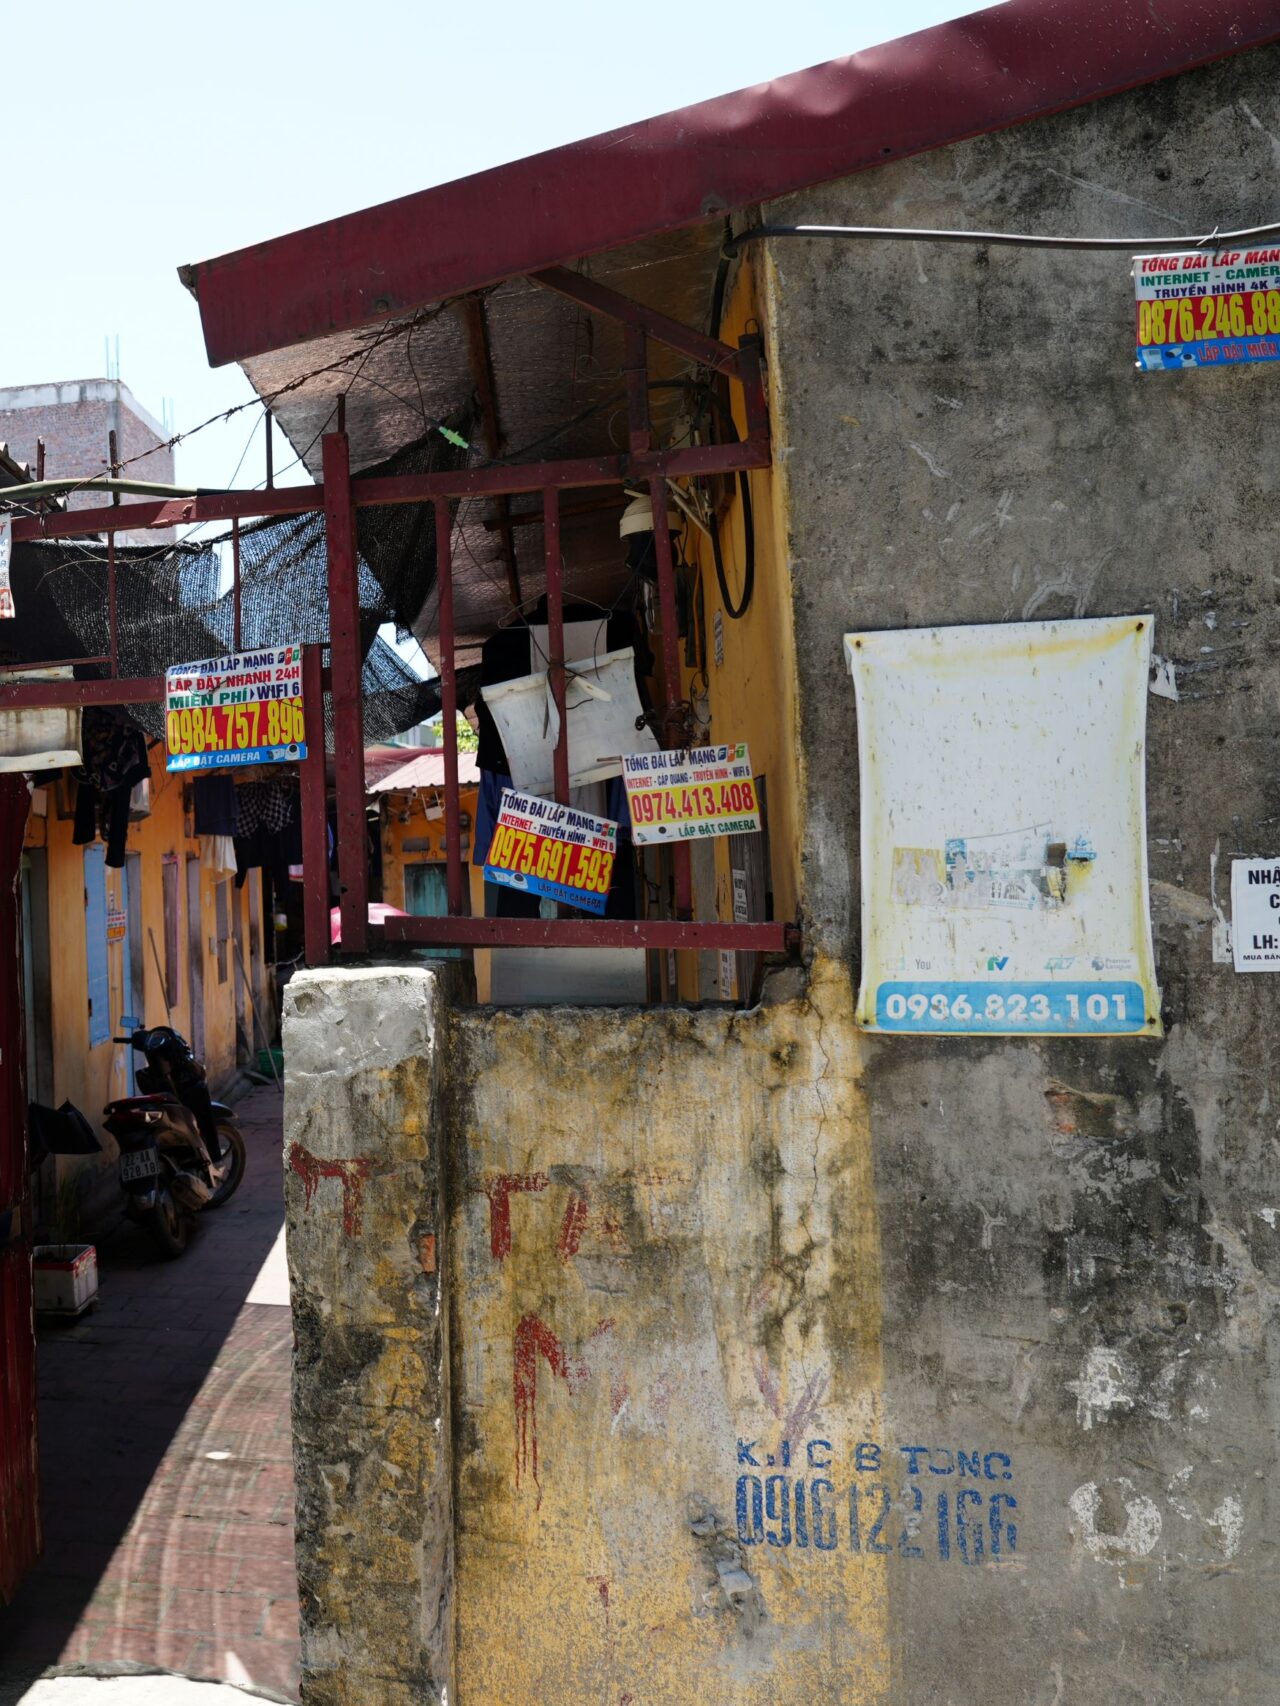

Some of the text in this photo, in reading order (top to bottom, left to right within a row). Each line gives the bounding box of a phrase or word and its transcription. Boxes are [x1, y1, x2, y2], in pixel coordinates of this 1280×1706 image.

[1142, 256, 1179, 272] TỔNG
[1212, 249, 1240, 267] LẮP
[1244, 249, 1280, 266] MẠN
[1141, 265, 1280, 286] INTERNET CAMER
[1155, 280, 1268, 298] TRUYỀN HÌNH 4K
[1139, 290, 1280, 345] 0876.246.88
[201, 660, 217, 675] ĐÀI
[221, 655, 240, 672] LẮP
[243, 653, 273, 670] MẠNG
[168, 666, 299, 693] LẮP ĐẶT NHANH 24H
[220, 688, 247, 703] PHÍ
[257, 683, 288, 699] WIFI
[292, 682, 299, 696] 6
[168, 698, 304, 755] 0984.757.896
[216, 751, 260, 764] CAMERA
[625, 755, 649, 772] TỔNG
[652, 754, 666, 769] ĐÀI
[689, 749, 716, 767] MẠNG
[718, 744, 745, 762] FPT
[733, 766, 746, 778] WIFI
[746, 766, 750, 776] 6
[503, 791, 529, 814] TỔNG
[529, 802, 547, 818] ĐÀI
[547, 805, 565, 823] LẮP
[567, 812, 595, 831] MẠNG
[631, 783, 754, 822] 0974.413.408
[501, 813, 533, 831] INTERNET
[540, 824, 566, 839] TRUYỀN
[567, 829, 586, 844] HÌNH
[593, 837, 608, 849] WIFI
[679, 820, 756, 837] LẮP ĐẶT CAMERA
[489, 825, 613, 894] 0975.691.593
[1248, 866, 1280, 887] NHẬ
[1253, 934, 1278, 949] LH:
[915, 958, 931, 970] You
[854, 1442, 882, 1472] B
